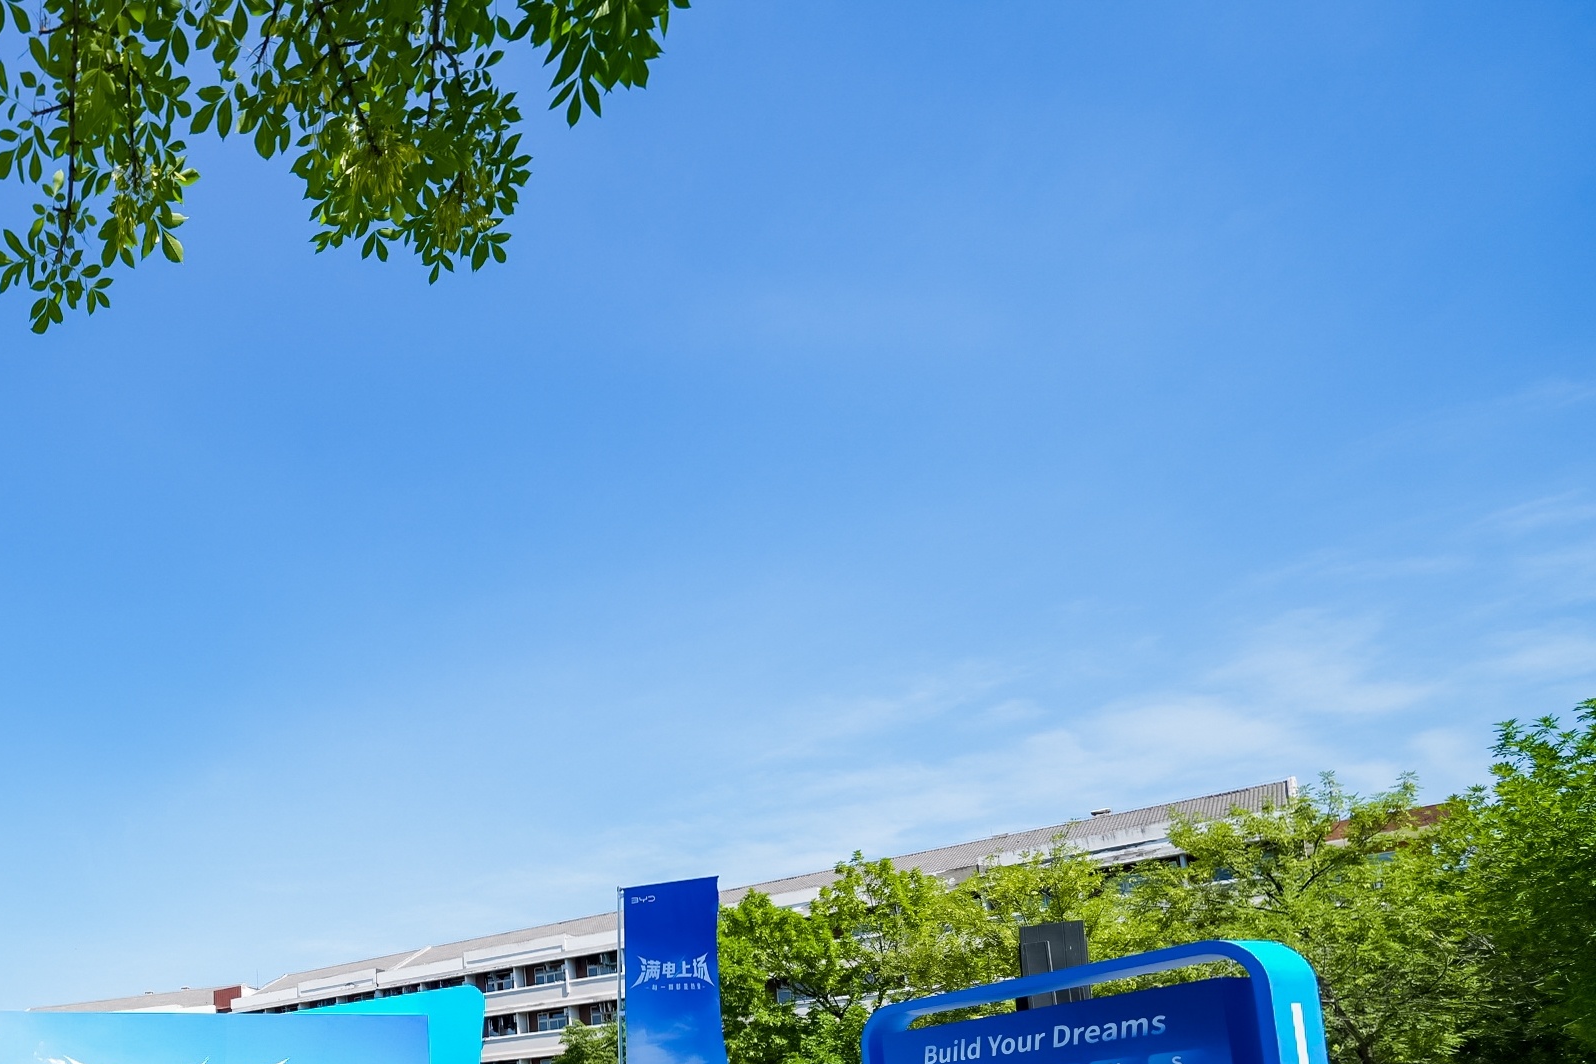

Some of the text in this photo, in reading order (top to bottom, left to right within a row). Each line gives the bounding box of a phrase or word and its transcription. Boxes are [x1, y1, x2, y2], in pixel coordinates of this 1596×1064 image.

[631, 895, 656, 905] BYD
[630, 952, 715, 989] 满电上场
[987, 1031, 1046, 1057] Your
[1053, 1014, 1166, 1048] Dreams
